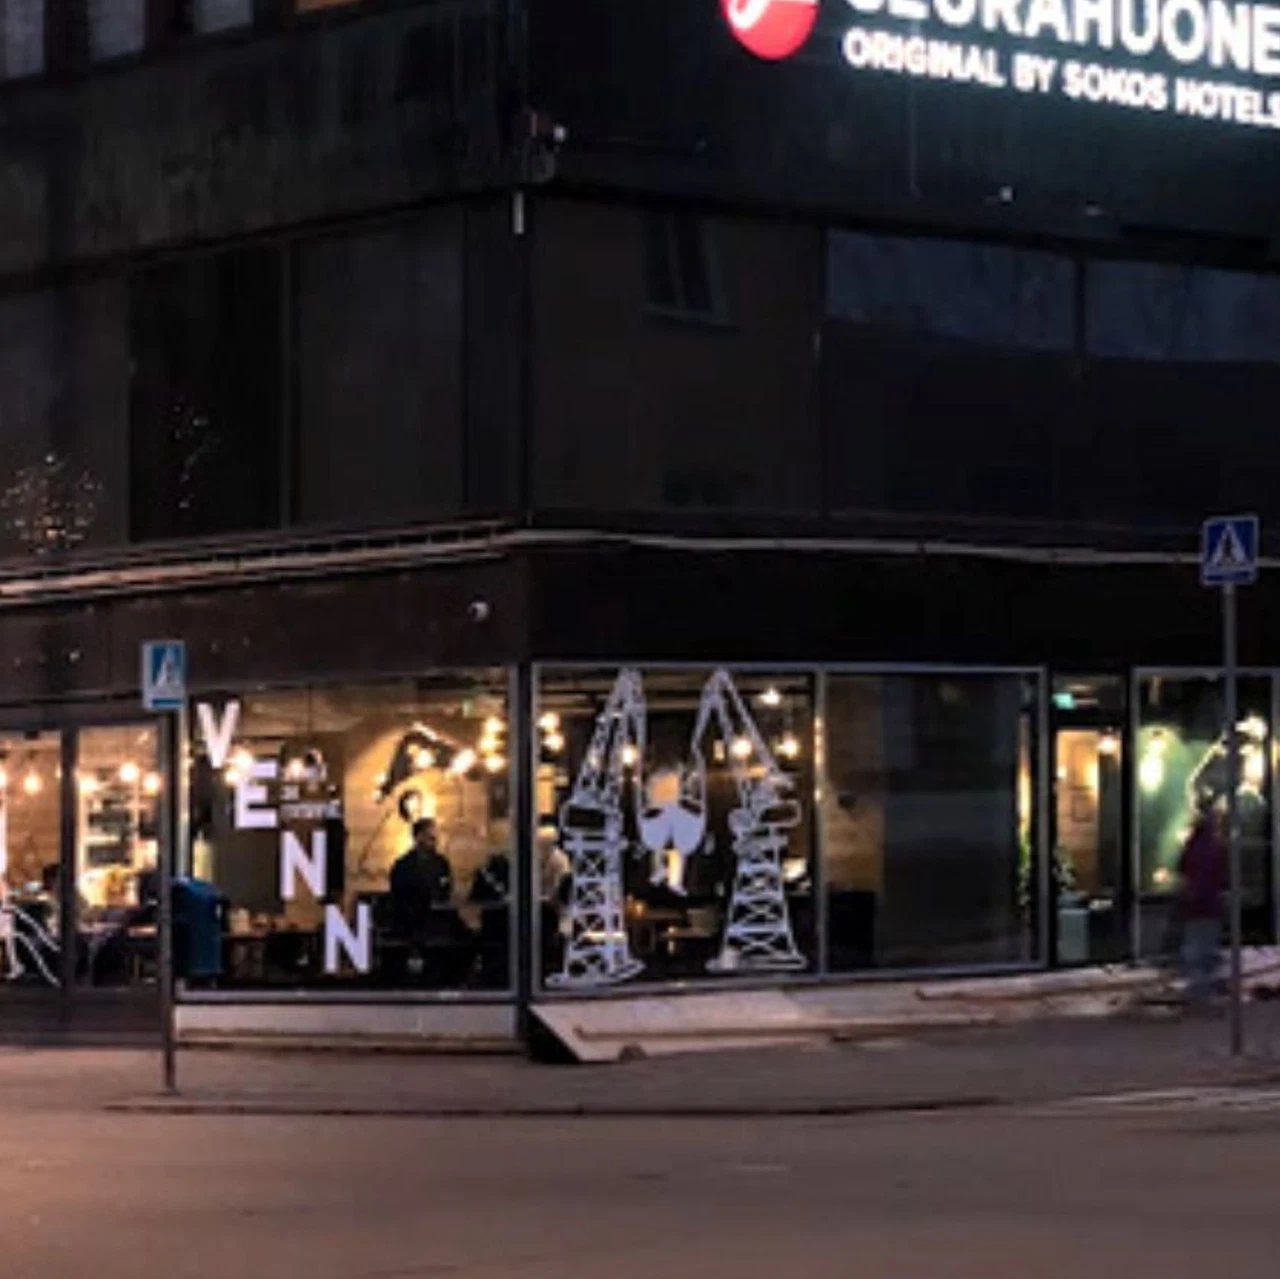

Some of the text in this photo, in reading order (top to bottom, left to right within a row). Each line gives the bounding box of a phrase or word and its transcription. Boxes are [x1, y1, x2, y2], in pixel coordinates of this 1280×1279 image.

[842, 27, 1005, 86] ORIGINAL
[1012, 53, 1054, 93] BY
[1061, 63, 1168, 111] SOKOS
